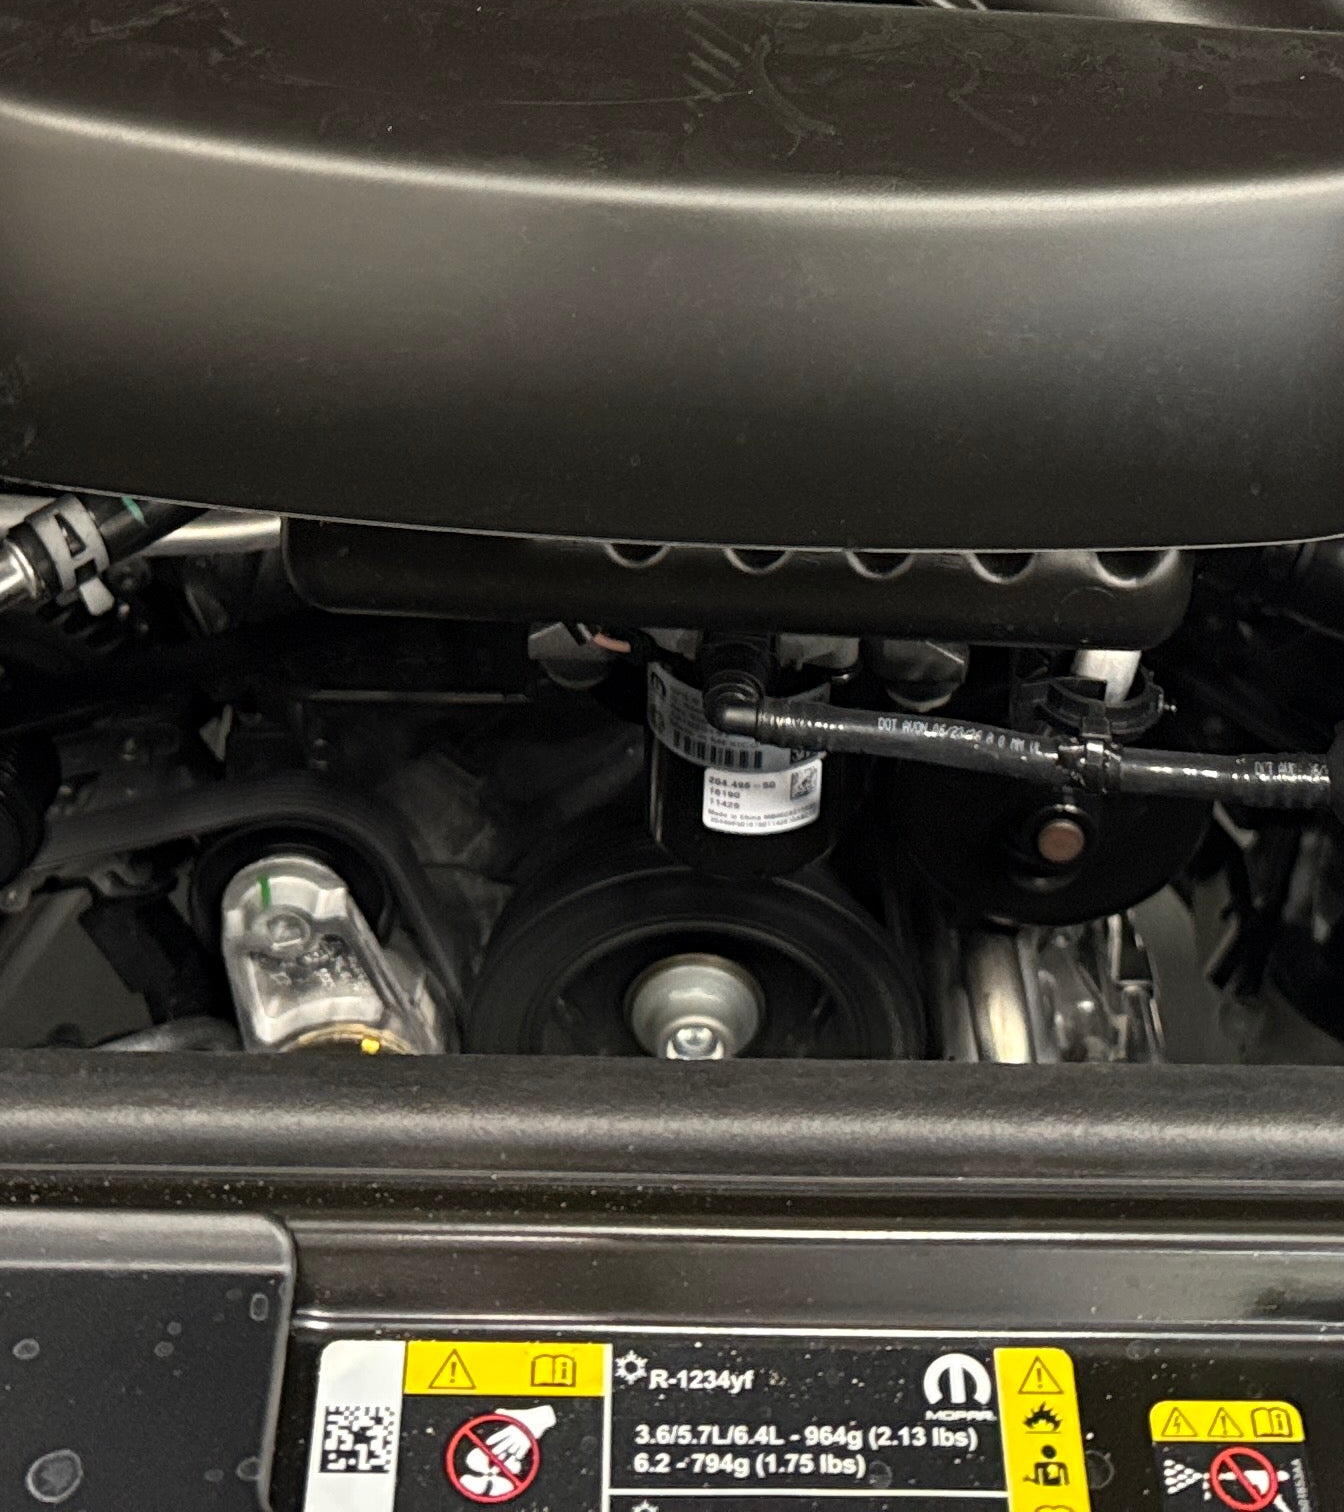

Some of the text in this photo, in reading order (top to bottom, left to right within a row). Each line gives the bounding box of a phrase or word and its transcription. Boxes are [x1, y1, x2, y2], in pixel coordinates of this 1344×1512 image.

[649, 1369, 754, 1394] R-1234yf
[634, 1424, 785, 1446] 3.6/5.7L/6.4L
[804, 1425, 863, 1450] 964g
[868, 1425, 926, 1451] (2.13
[932, 1425, 978, 1451] lbs)
[634, 1453, 671, 1474] 6.2
[691, 1453, 750, 1478] 794g
[755, 1453, 814, 1479] (1.75
[819, 1453, 866, 1479] lbs)
